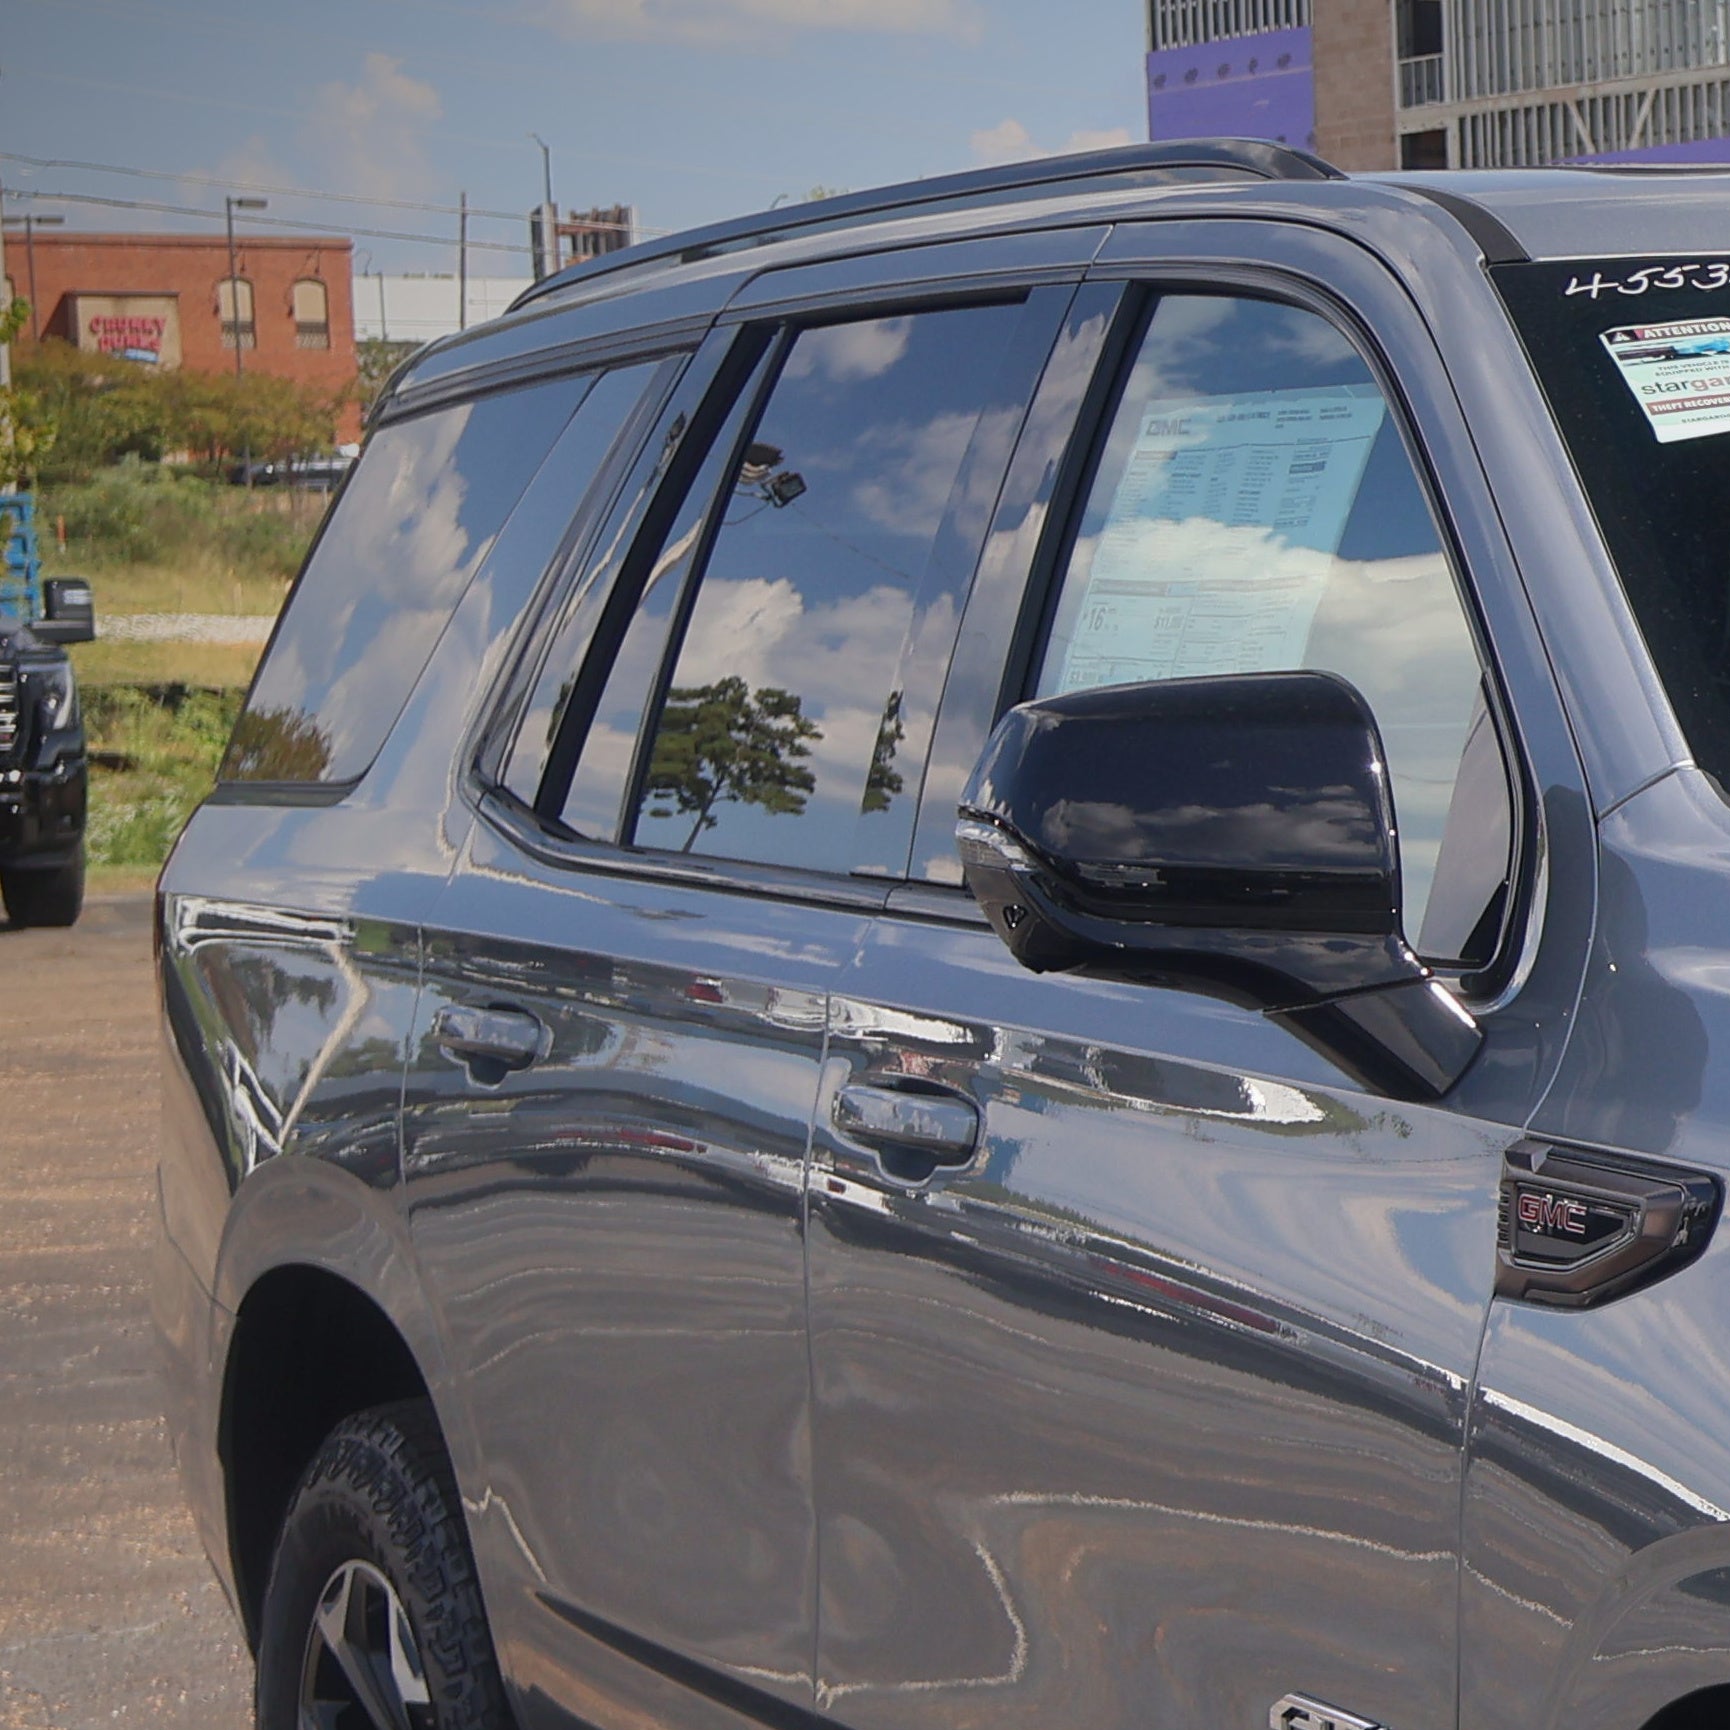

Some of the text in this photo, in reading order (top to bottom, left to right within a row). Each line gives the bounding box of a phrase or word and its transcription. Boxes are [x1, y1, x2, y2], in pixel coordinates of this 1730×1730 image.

[1652, 402, 1683, 412] THEFT
[1146, 418, 1192, 437] GMC
[1518, 1193, 1588, 1235] GMC
